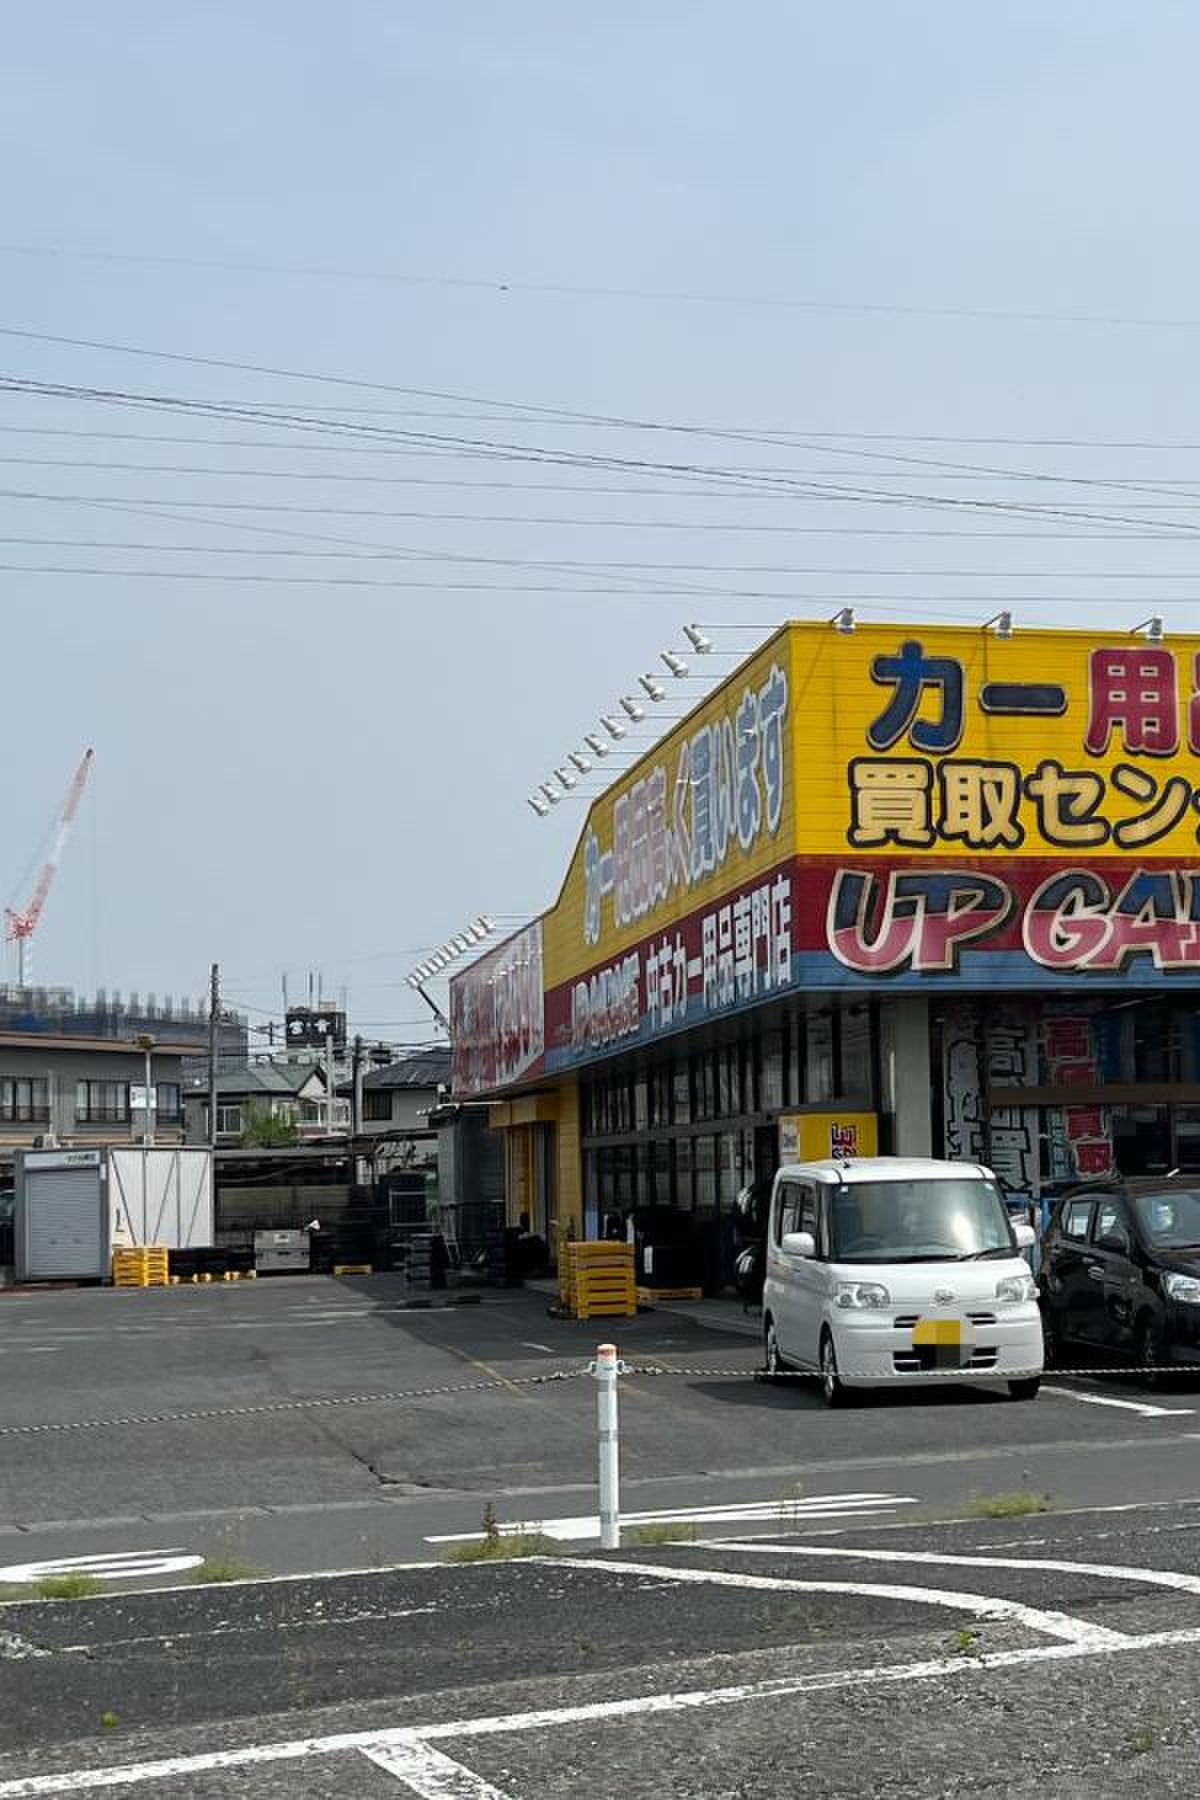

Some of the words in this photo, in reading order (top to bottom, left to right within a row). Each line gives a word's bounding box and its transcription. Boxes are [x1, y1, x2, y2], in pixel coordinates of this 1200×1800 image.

[646, 873, 791, 1032] 中古カー用品専門店
[826, 868, 1013, 974] UP
